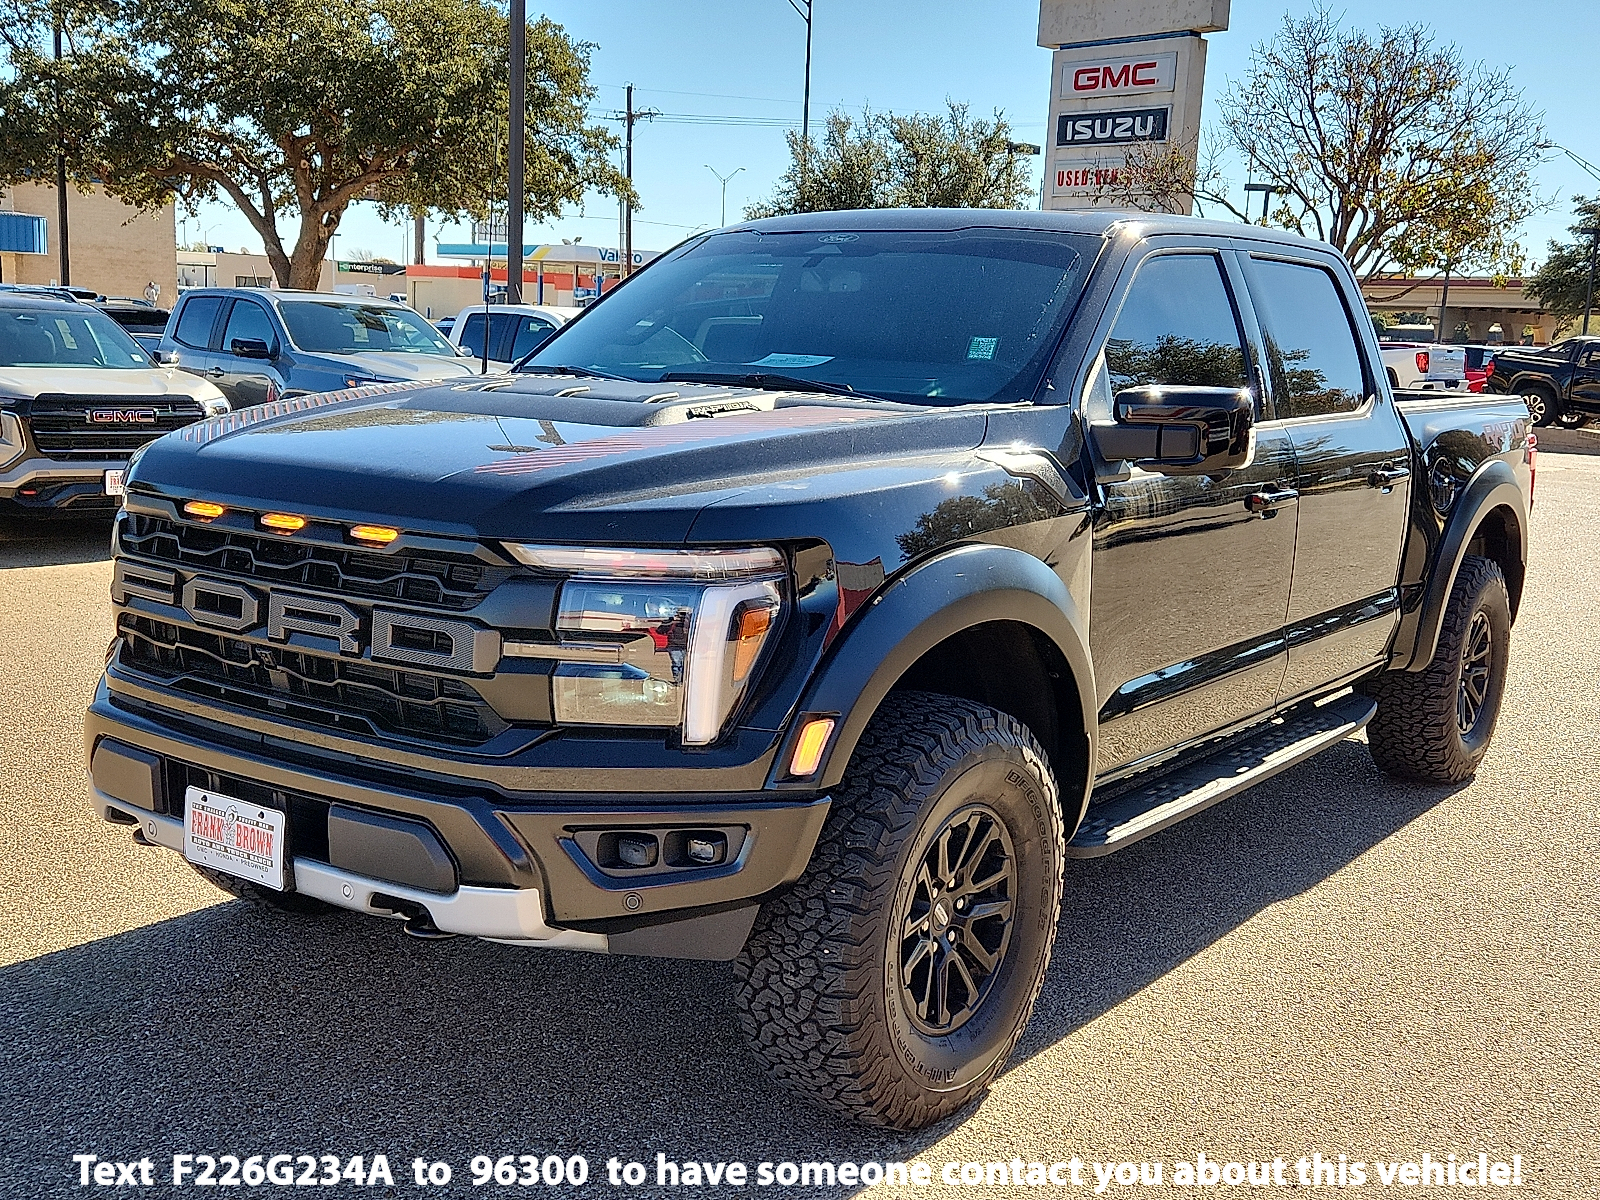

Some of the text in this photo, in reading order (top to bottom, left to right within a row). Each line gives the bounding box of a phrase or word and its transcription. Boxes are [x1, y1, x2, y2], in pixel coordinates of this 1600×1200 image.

[1073, 62, 1157, 91] GMC
[1066, 115, 1154, 141] ISUZU
[1057, 167, 1089, 187] USED
[340, 263, 383, 273] enterprise
[93, 410, 155, 423] GMC
[112, 558, 502, 674] FORD
[192, 810, 274, 858] FRANK BROWN
